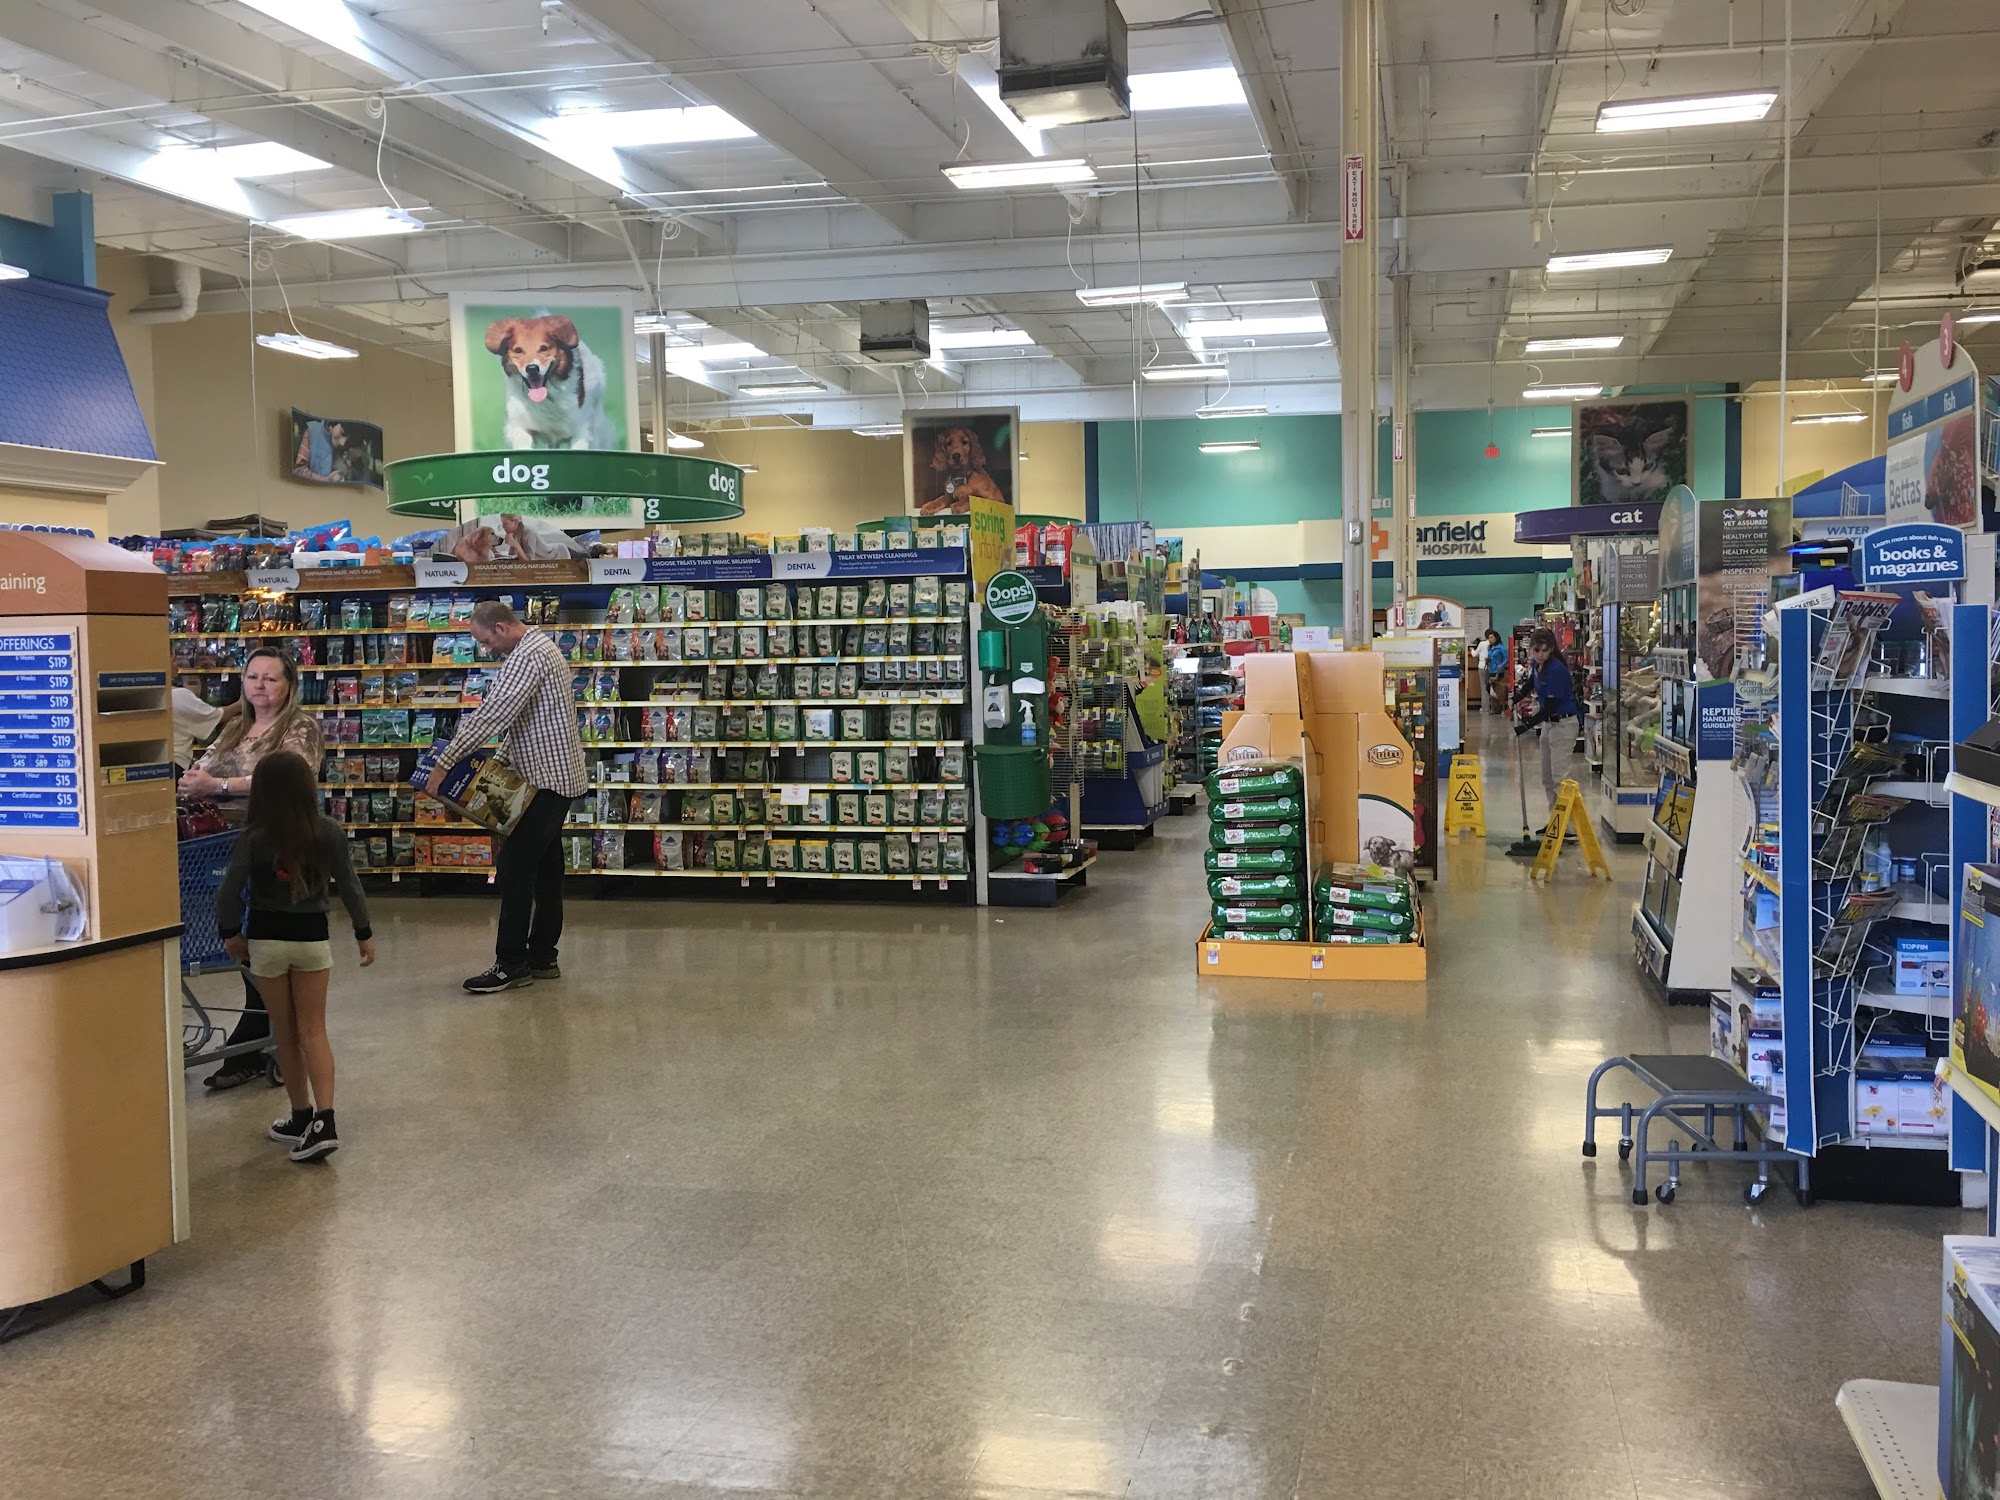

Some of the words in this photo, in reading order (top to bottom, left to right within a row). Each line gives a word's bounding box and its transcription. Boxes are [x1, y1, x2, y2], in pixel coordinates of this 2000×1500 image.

[1347, 161, 1362, 170] FIRE
[1902, 354, 1908, 378] 4
[1943, 391, 1956, 413] fish
[1902, 411, 1913, 431] fish
[492, 457, 550, 490] dog
[708, 467, 735, 501] dog
[1889, 477, 1921, 510] Bettas
[1610, 509, 1643, 524] cat
[974, 511, 1005, 542] spring
[1416, 520, 1487, 542] anfield
[1827, 526, 1869, 535] WATER
[1423, 543, 1486, 555] HOSPITAL
[1872, 539, 1891, 549] Learn
[1939, 536, 1953, 544] with
[1880, 546, 1931, 561] books
[1933, 545, 1947, 558] &
[425, 570, 457, 578] NATURAL
[604, 568, 631, 576] DENTAL
[1722, 567, 1768, 575] INSPECTION
[1870, 560, 1958, 577] magazines
[0, 573, 46, 594] aining
[989, 580, 1031, 601] Oops!
[0, 638, 55, 650] OFFERINGS
[48, 656, 68, 669] $119
[49, 676, 69, 688] $119
[49, 695, 69, 708] $119
[1702, 708, 1741, 716] REPTILE
[51, 715, 70, 728] $119
[52, 734, 71, 747] $119
[1227, 750, 1260, 762] Nutro
[1368, 748, 1403, 763] Nutro
[13, 758, 25, 767] $45
[35, 758, 48, 767] $89
[57, 758, 71, 767] $219
[55, 774, 70, 787] $15
[452, 782, 464, 798] Training
[57, 793, 72, 806] $15
